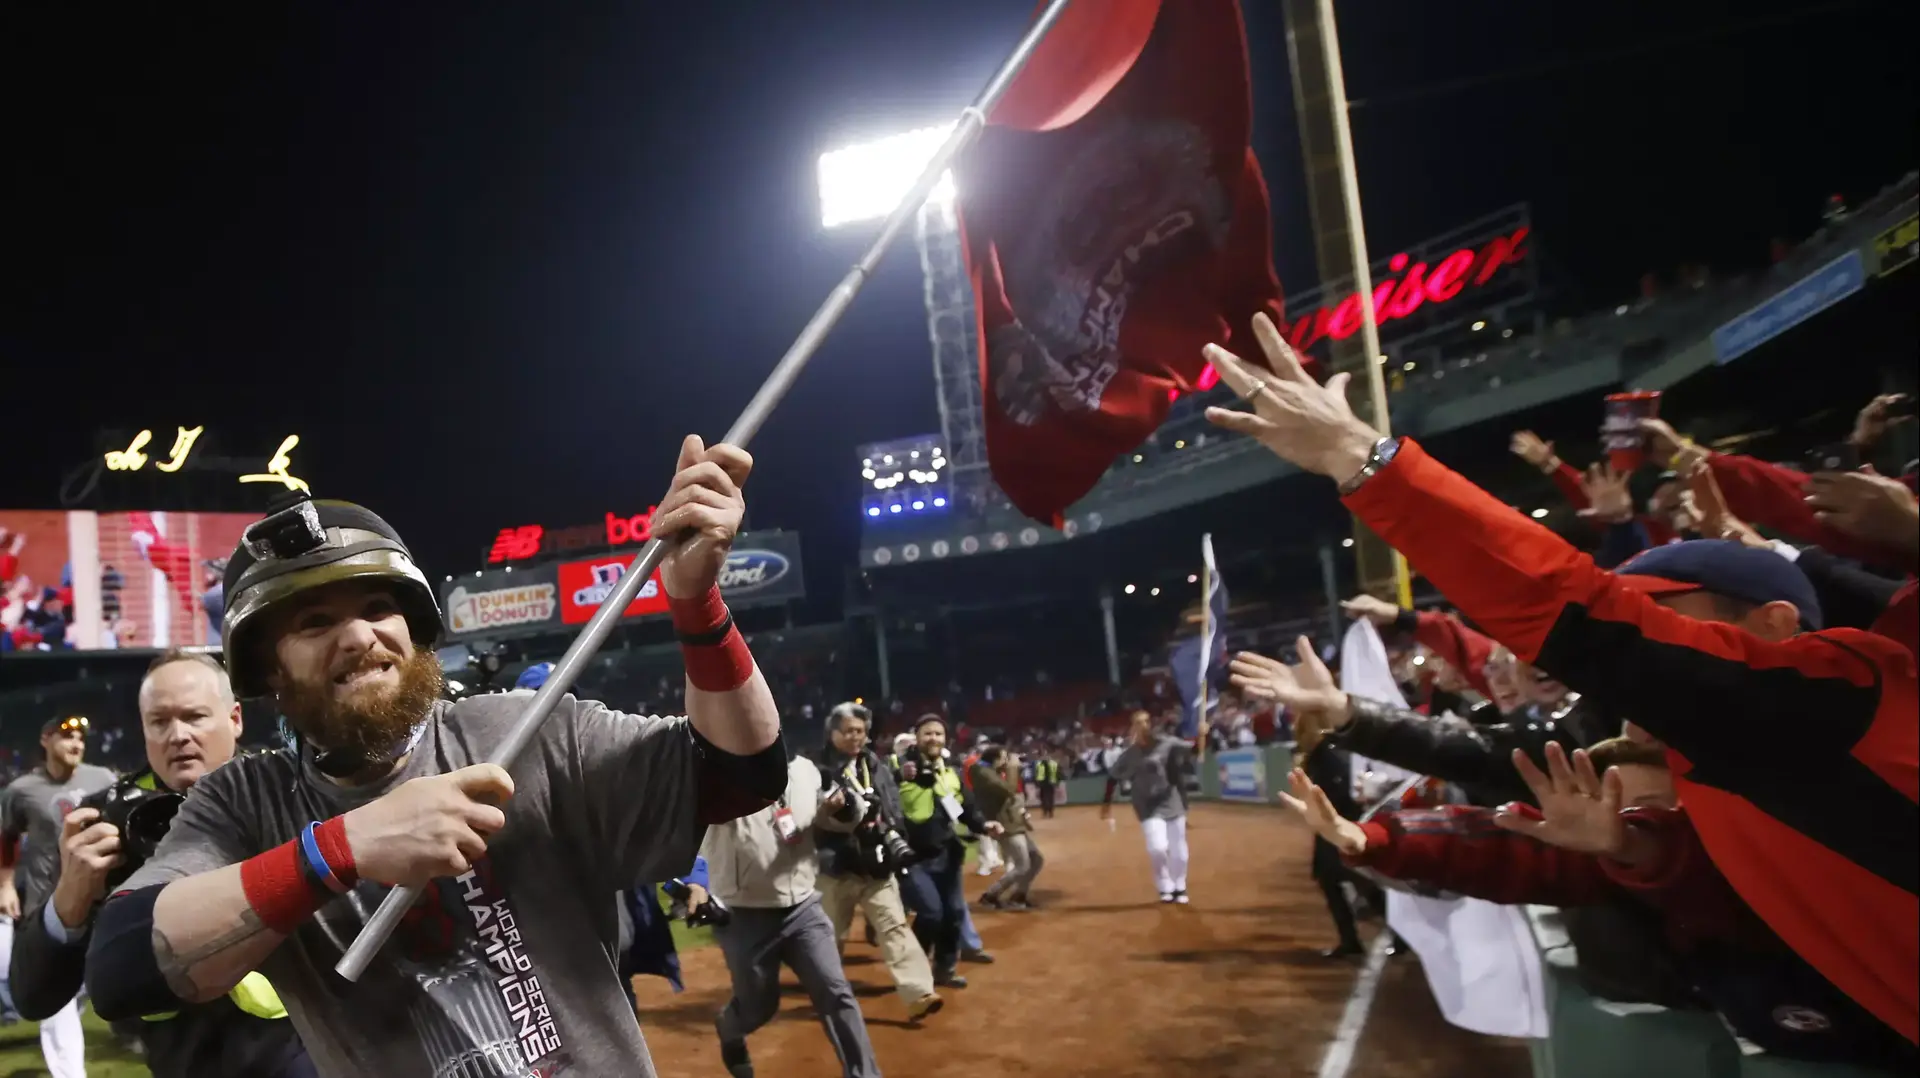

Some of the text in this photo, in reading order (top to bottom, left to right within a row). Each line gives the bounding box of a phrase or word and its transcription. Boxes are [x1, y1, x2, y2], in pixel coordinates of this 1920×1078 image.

[480, 602, 549, 624] DONUTS
[456, 869, 546, 1064] HAMPIONS
[491, 898, 562, 1053] WORLD SERIES
